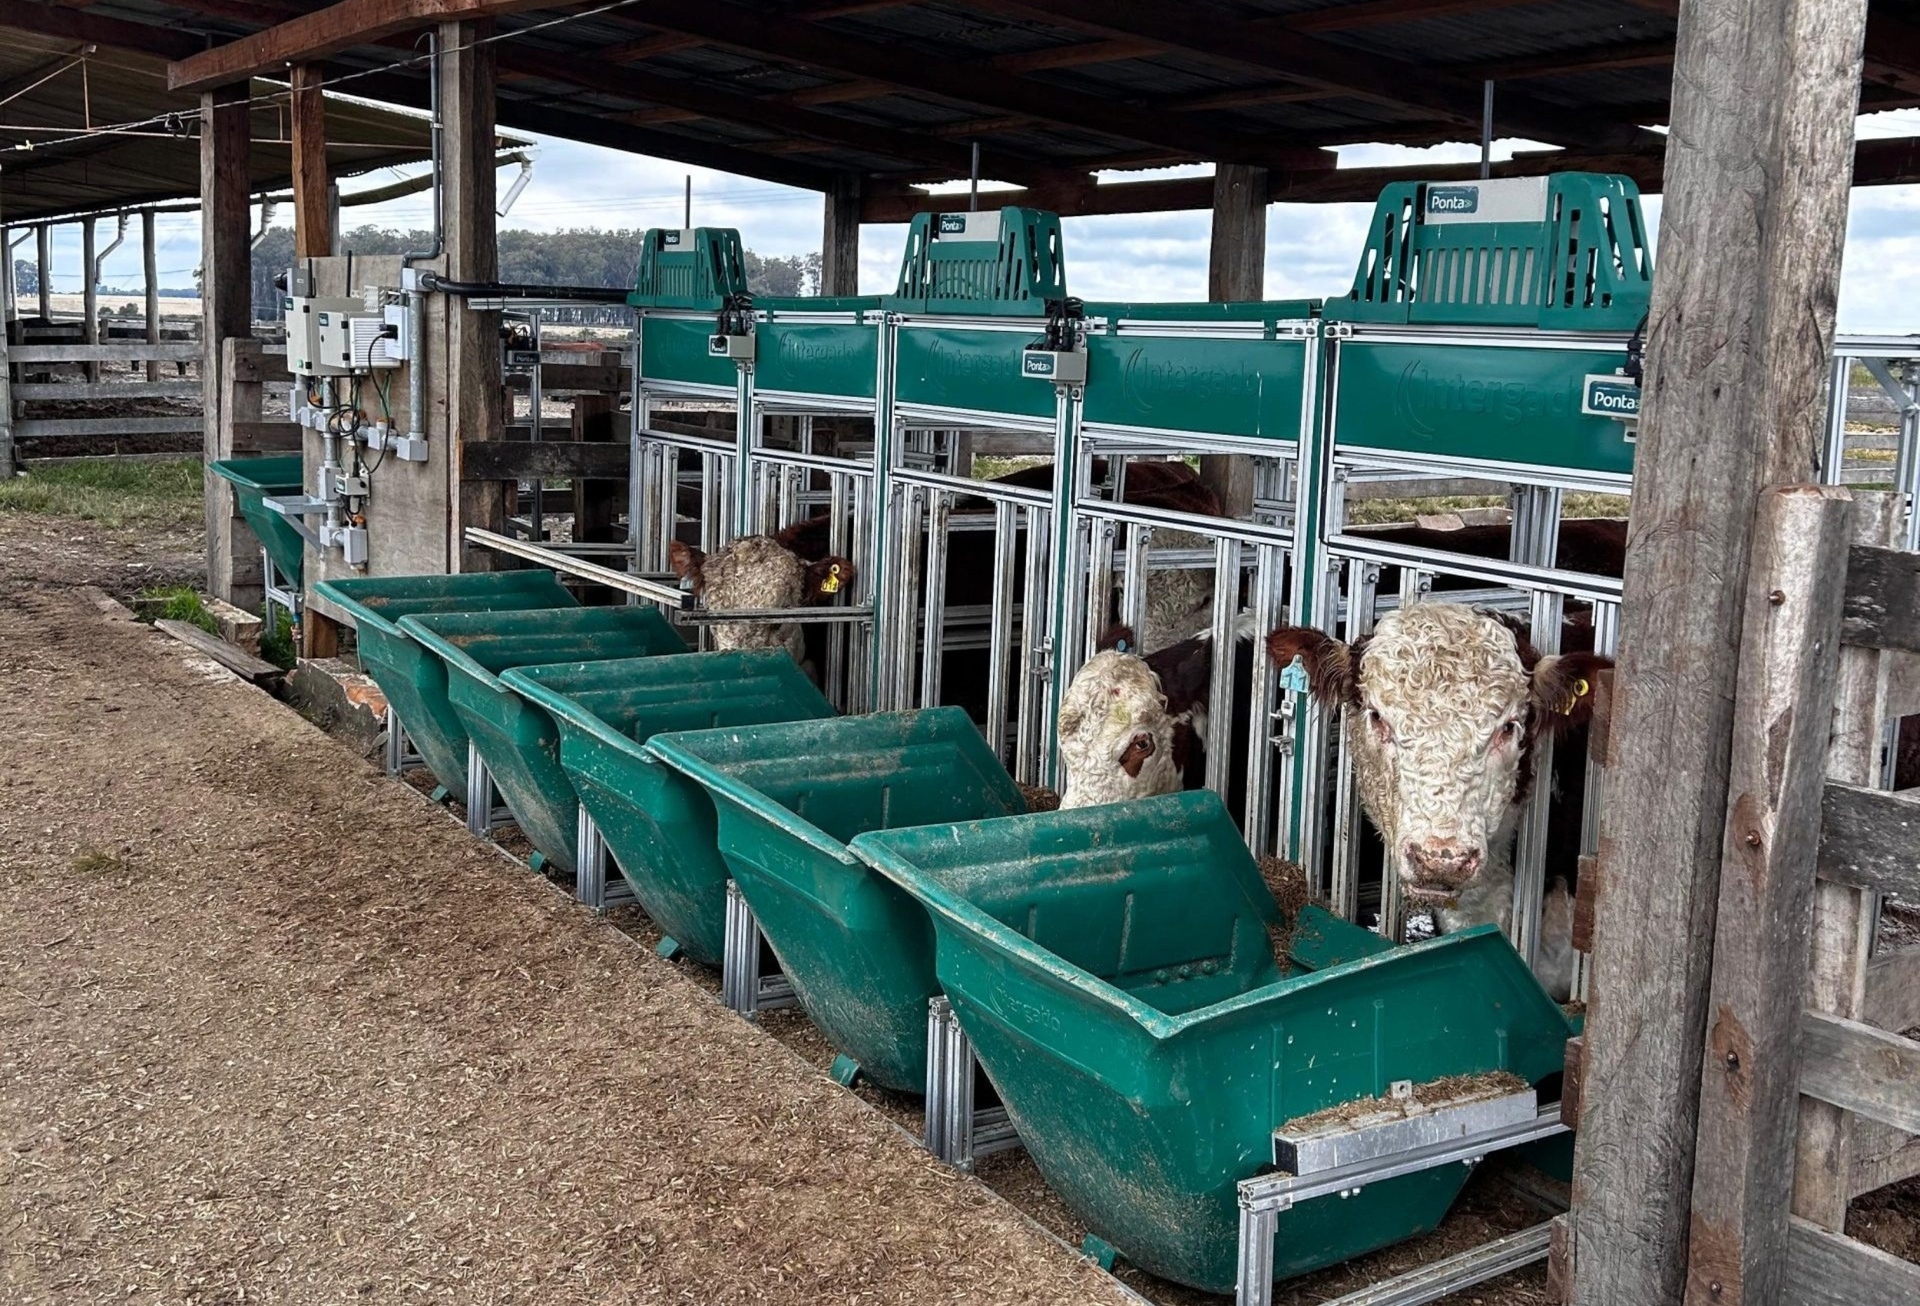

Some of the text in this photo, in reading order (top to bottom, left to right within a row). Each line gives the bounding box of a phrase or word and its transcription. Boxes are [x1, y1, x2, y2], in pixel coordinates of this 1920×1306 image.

[1431, 195, 1465, 209] Ponta
[941, 220, 959, 231] Ponta
[1027, 360, 1047, 371] Ponta
[1594, 391, 1636, 409] Ponta
